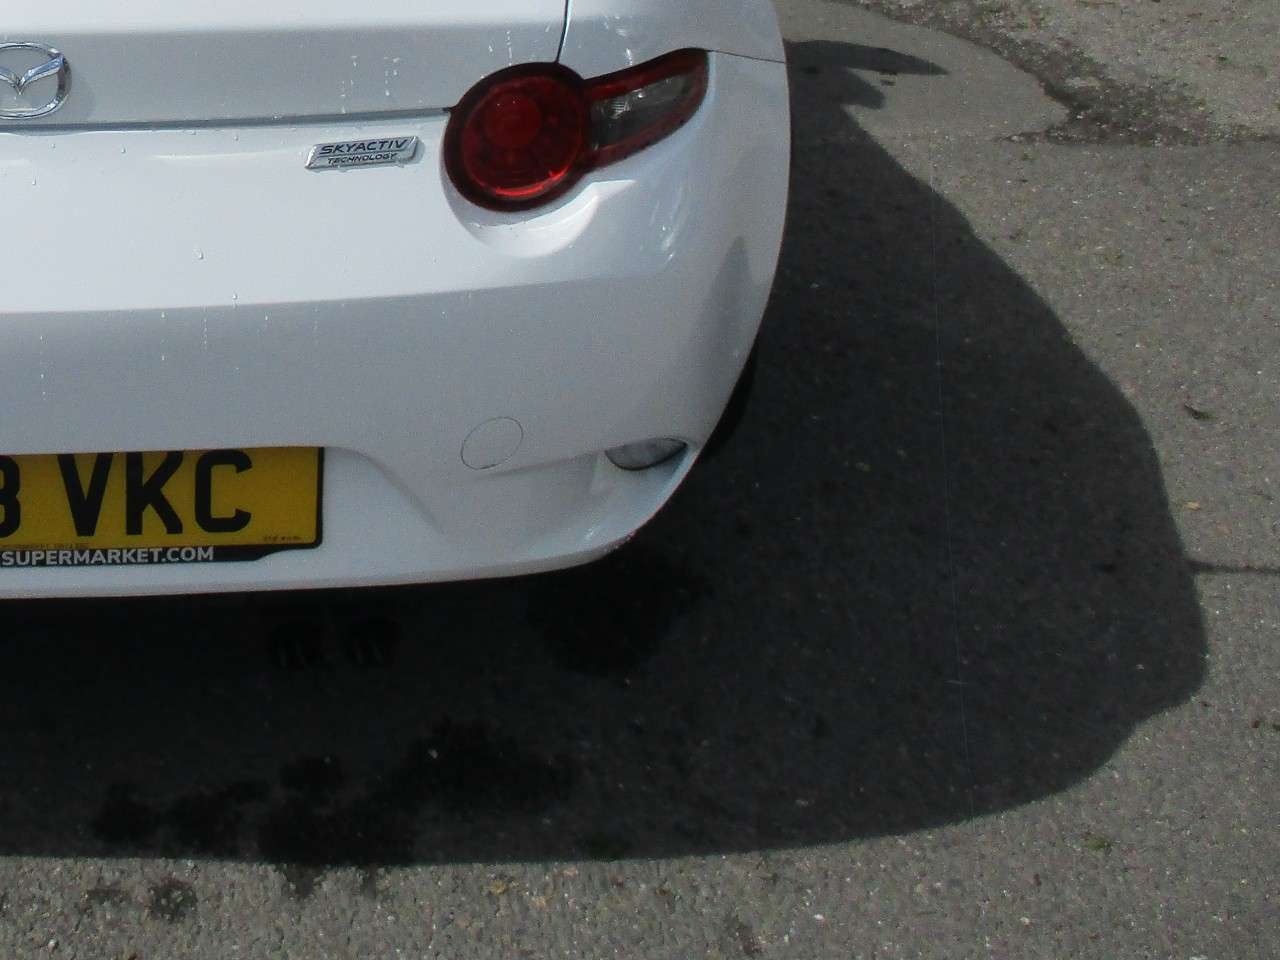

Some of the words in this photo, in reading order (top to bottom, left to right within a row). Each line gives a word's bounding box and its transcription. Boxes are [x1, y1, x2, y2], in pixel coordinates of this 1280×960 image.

[320, 139, 408, 155] SKYACTIV
[327, 153, 399, 165] TECHNOLOGY
[57, 449, 253, 537] VKC
